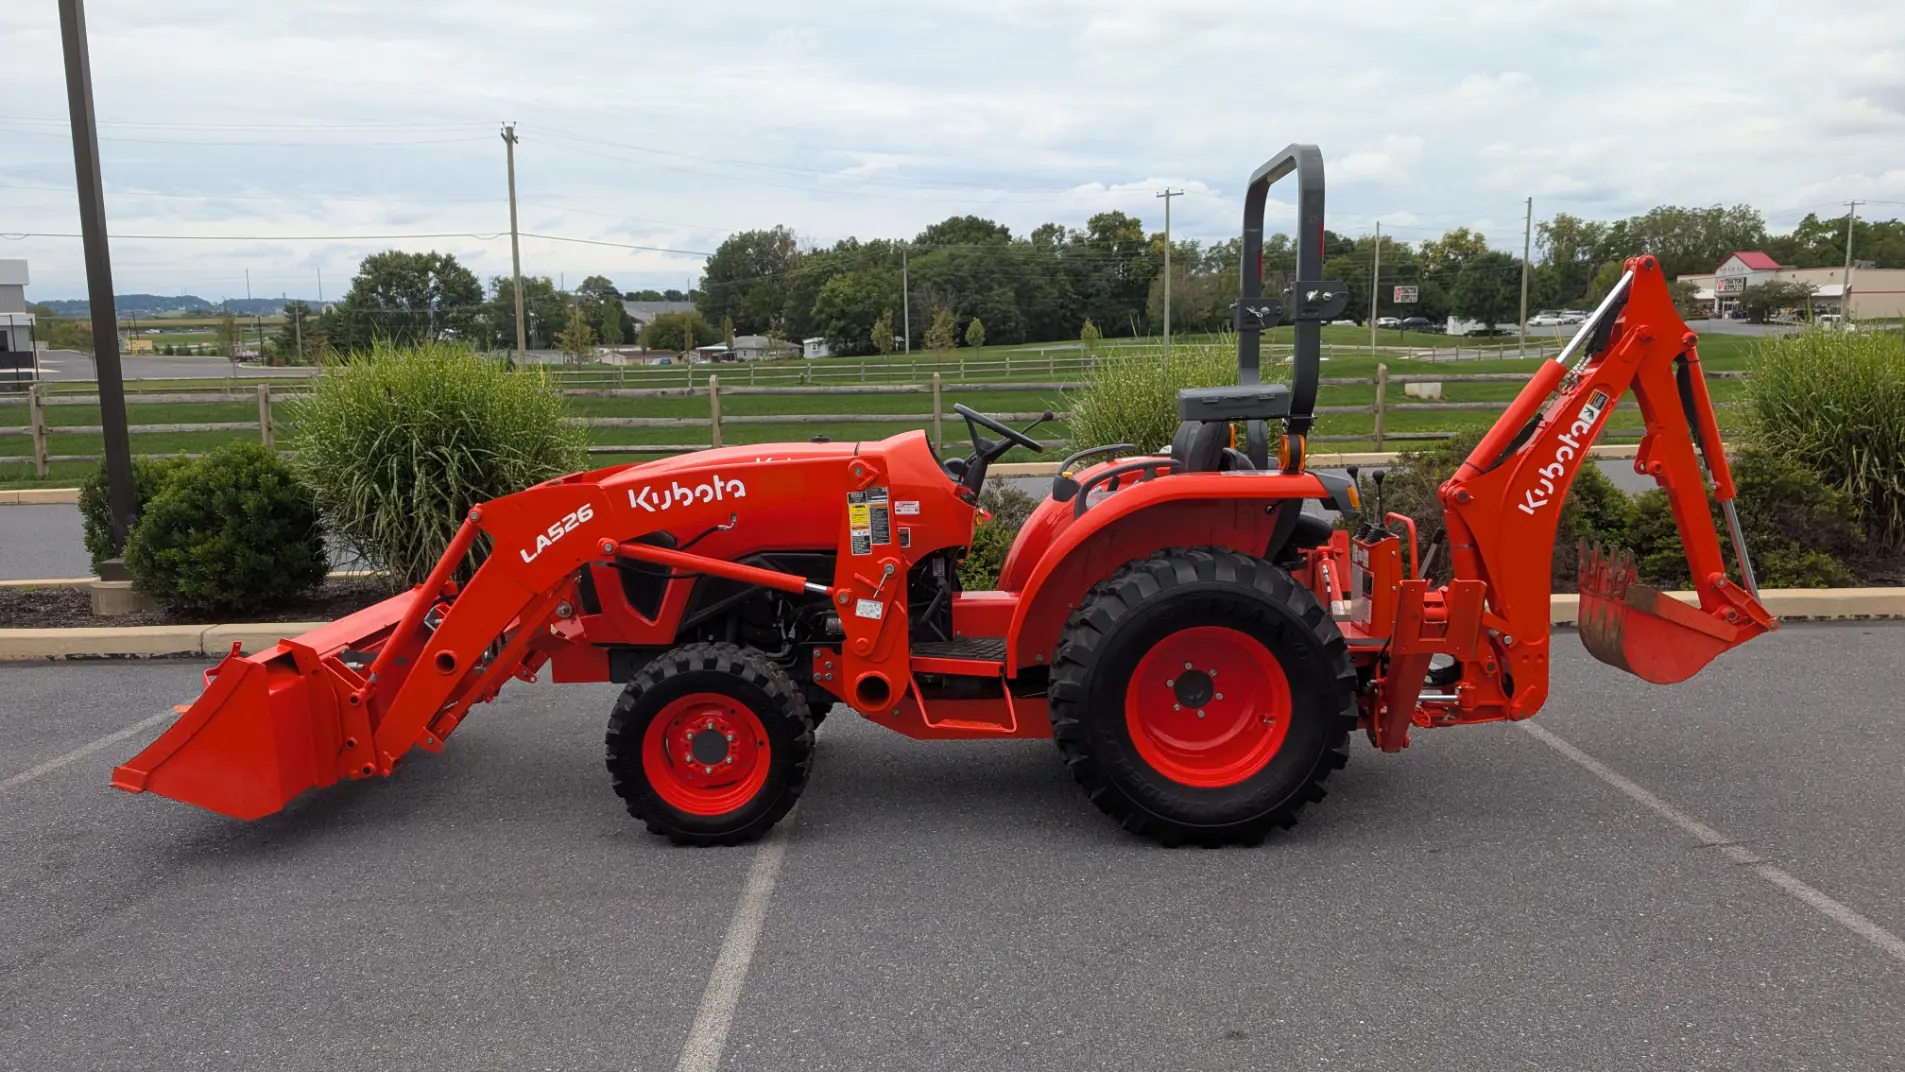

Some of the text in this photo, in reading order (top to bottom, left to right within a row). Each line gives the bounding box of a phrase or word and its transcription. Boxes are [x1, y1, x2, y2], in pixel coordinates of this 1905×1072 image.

[627, 474, 746, 512] Kubota
[1518, 420, 1592, 515] Kubota
[519, 503, 594, 564] LA526
